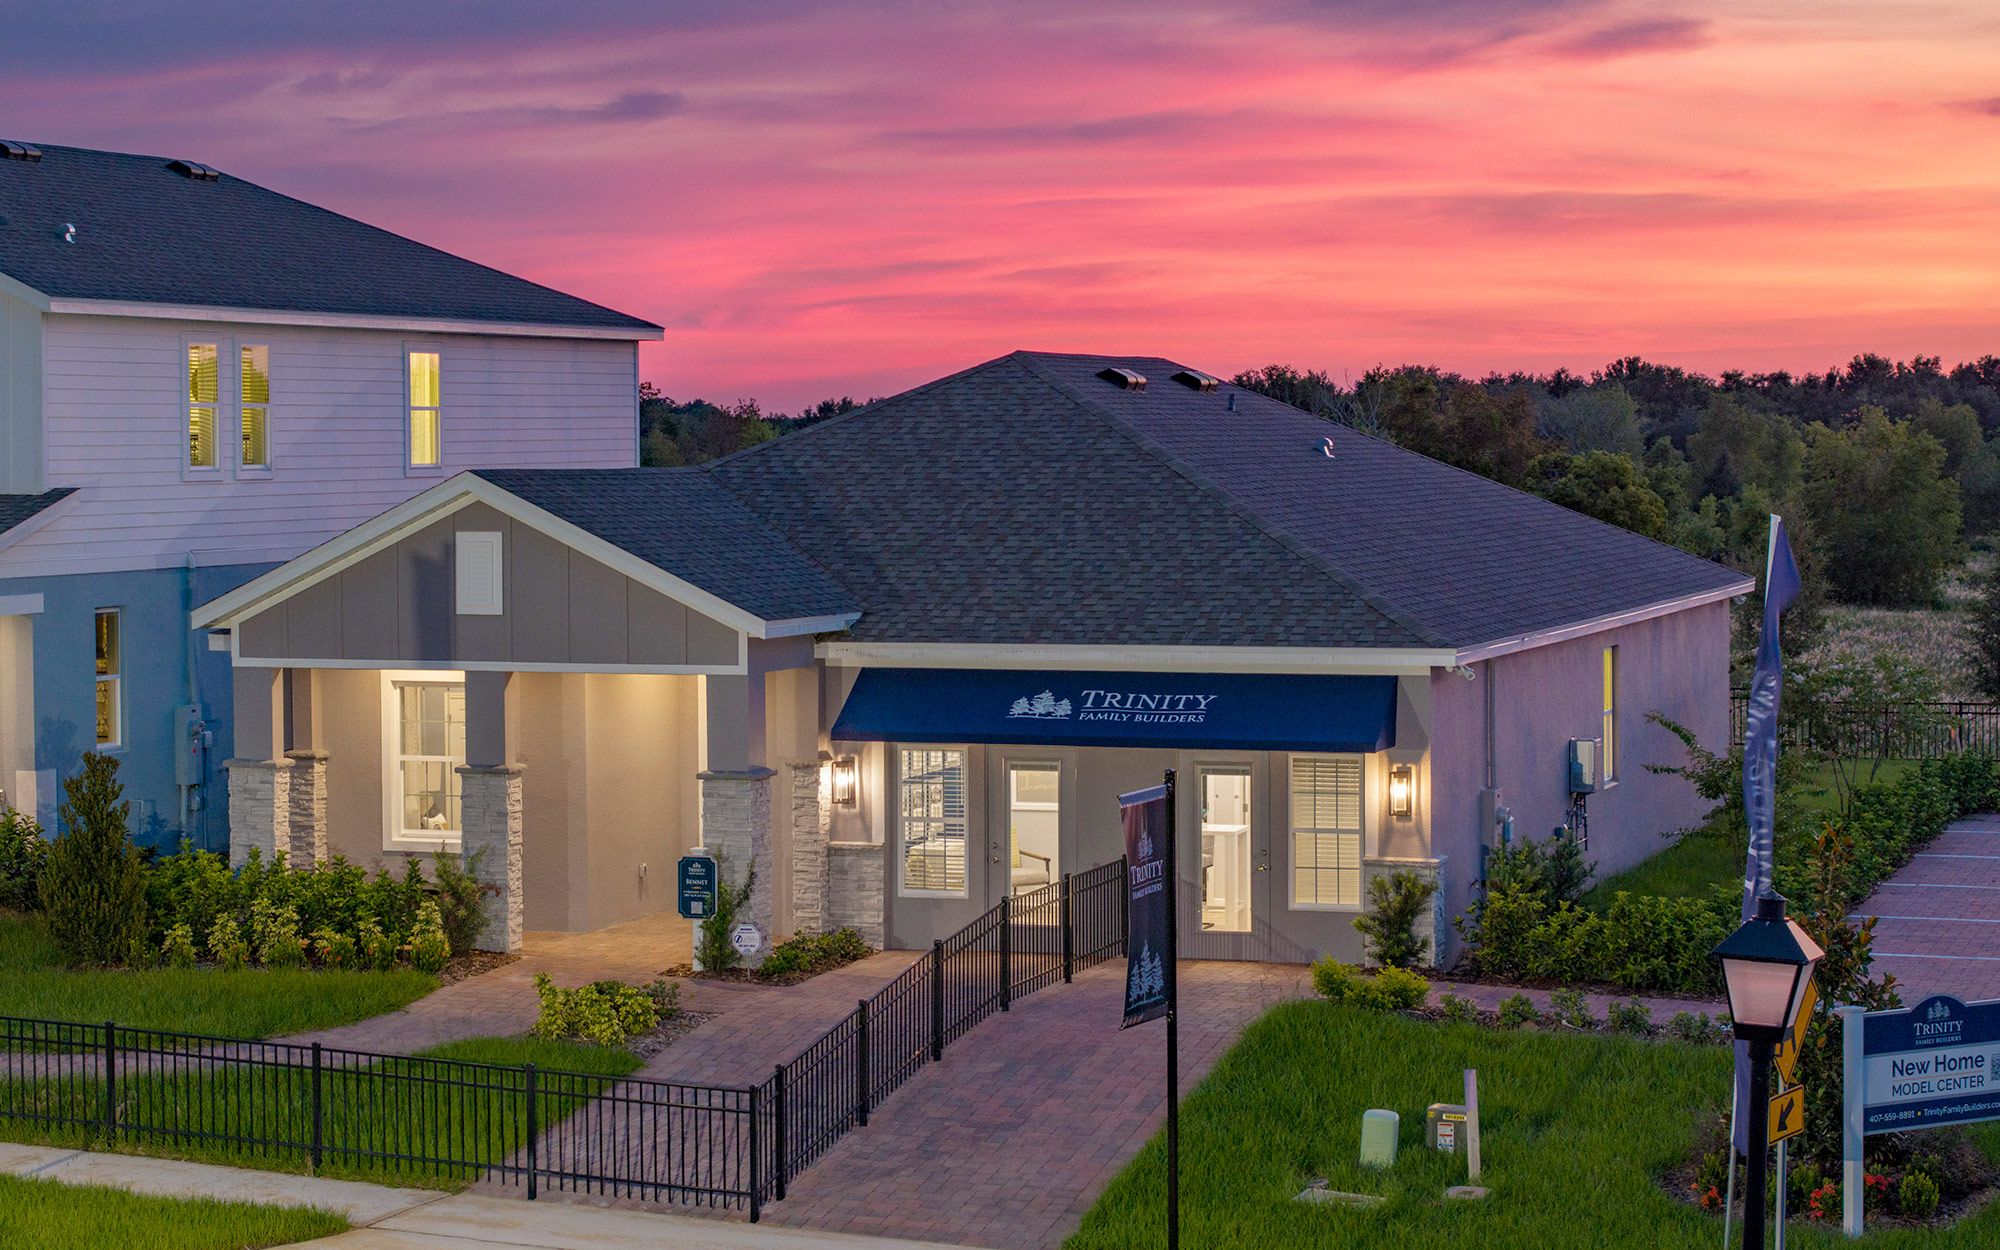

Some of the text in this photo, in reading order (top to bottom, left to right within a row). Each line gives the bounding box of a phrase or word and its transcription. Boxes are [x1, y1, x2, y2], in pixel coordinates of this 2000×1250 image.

[1081, 690, 1218, 710] TRINITY
[1079, 712, 1205, 723] FAMILY BUILDERS
[1131, 860, 1163, 885] TRINITY
[1913, 1020, 1963, 1036] TRINITY
[1892, 1054, 1985, 1078] New Home
[1892, 1074, 1985, 1097] MODEL CENTER
[1869, 1110, 1915, 1122] 407-559-8891
